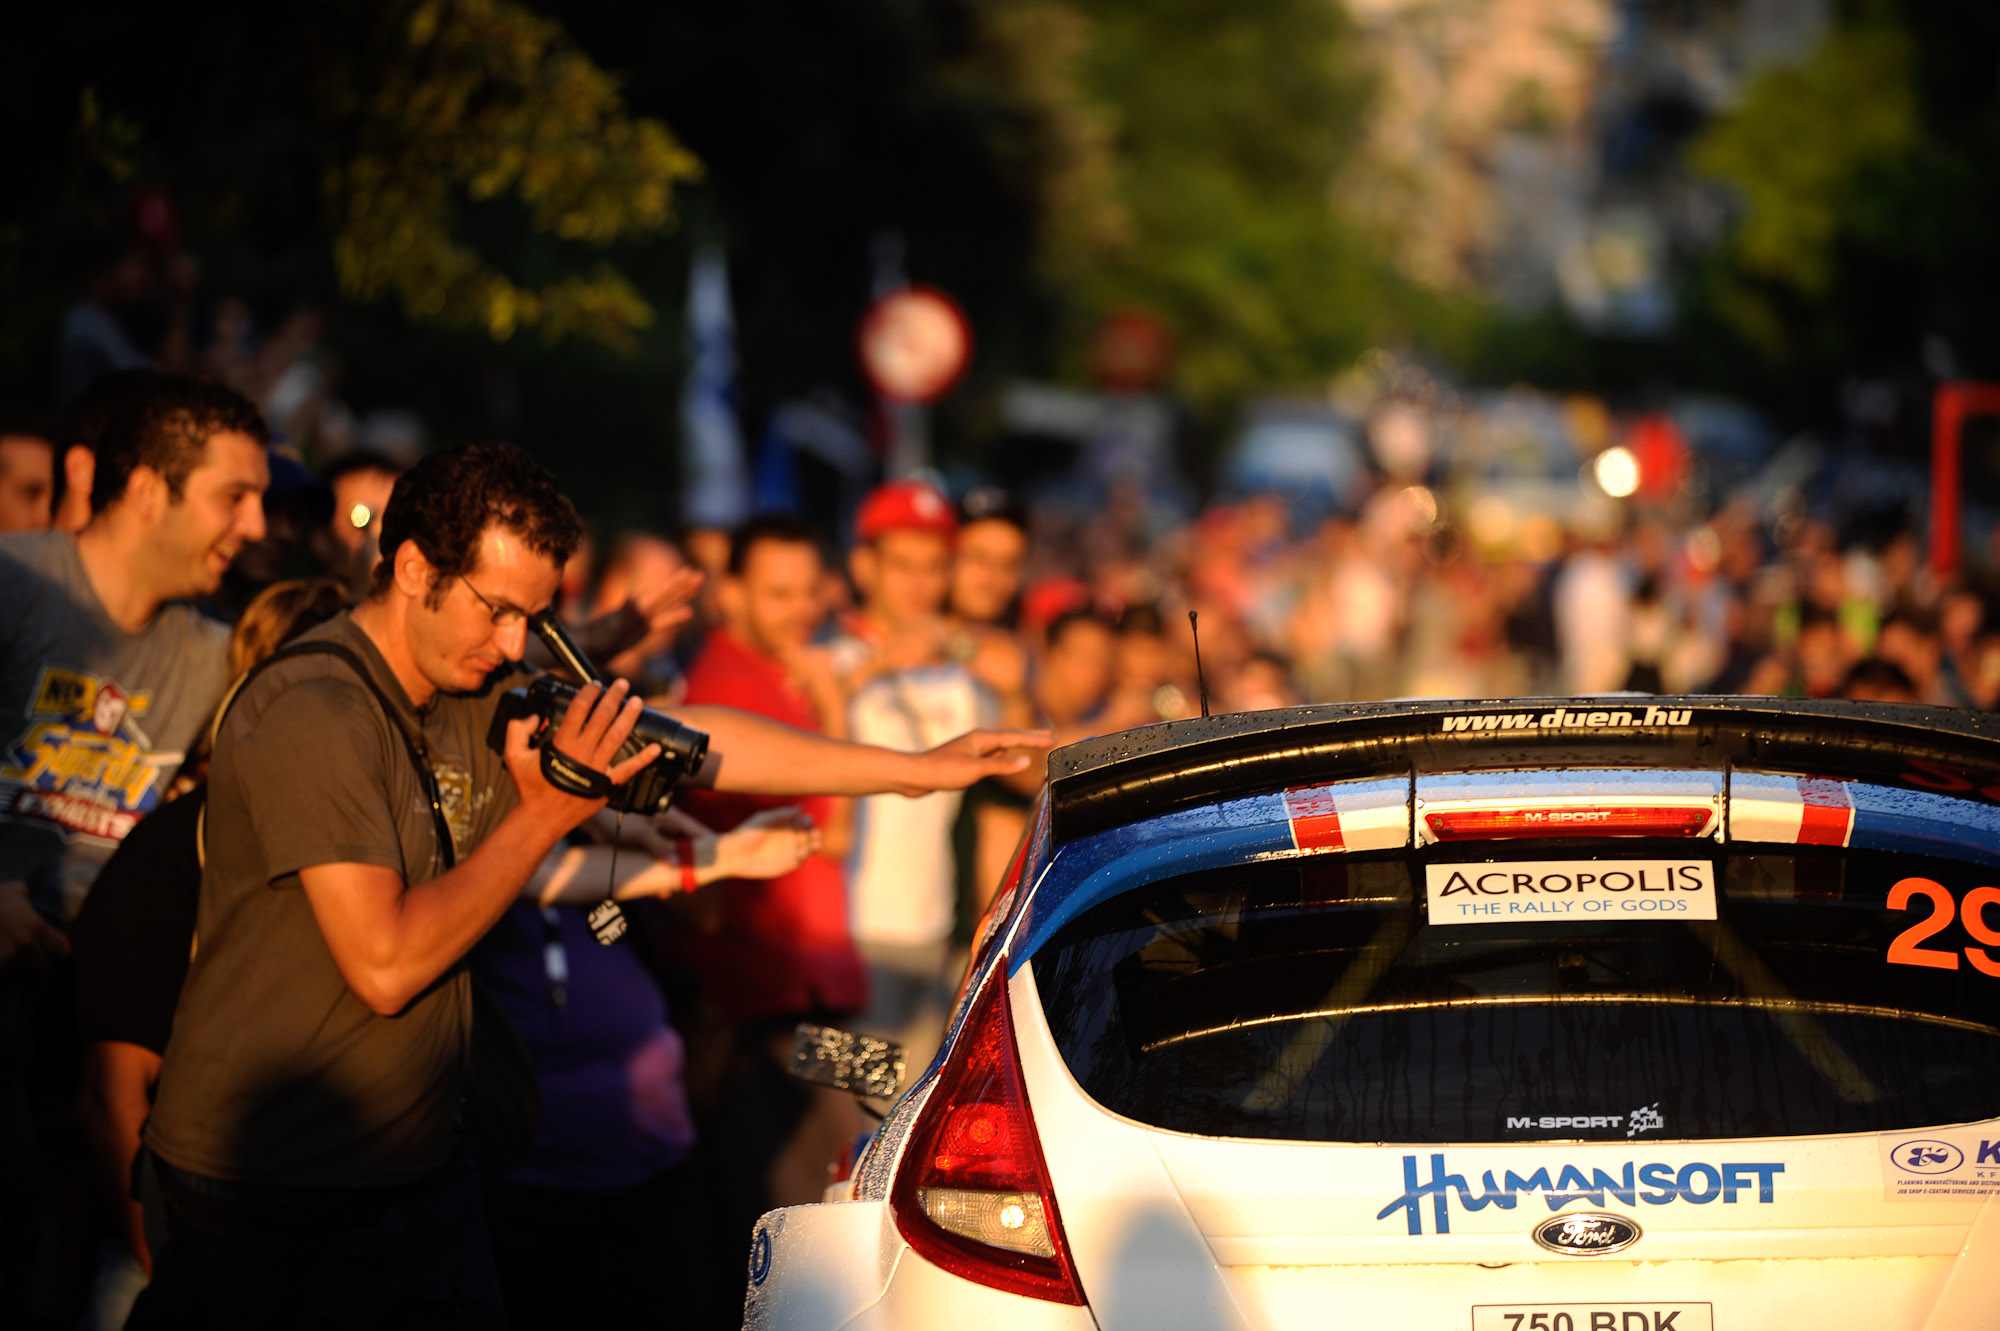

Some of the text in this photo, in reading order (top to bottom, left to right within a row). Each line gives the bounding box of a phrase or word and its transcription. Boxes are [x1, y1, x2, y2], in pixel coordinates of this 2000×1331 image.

[1442, 707, 1693, 732] www.duen.hu
[550, 757, 593, 789] Panasonic
[1524, 811, 1612, 823] M-SPORT
[1439, 865, 1704, 898] ACROPOLIS
[1457, 899, 1688, 915] THE RALLY OF GODS
[1886, 876, 2000, 978] 29
[1506, 1116, 1624, 1129] M-SPORT
[1503, 1311, 1682, 1331] 750 BDK
